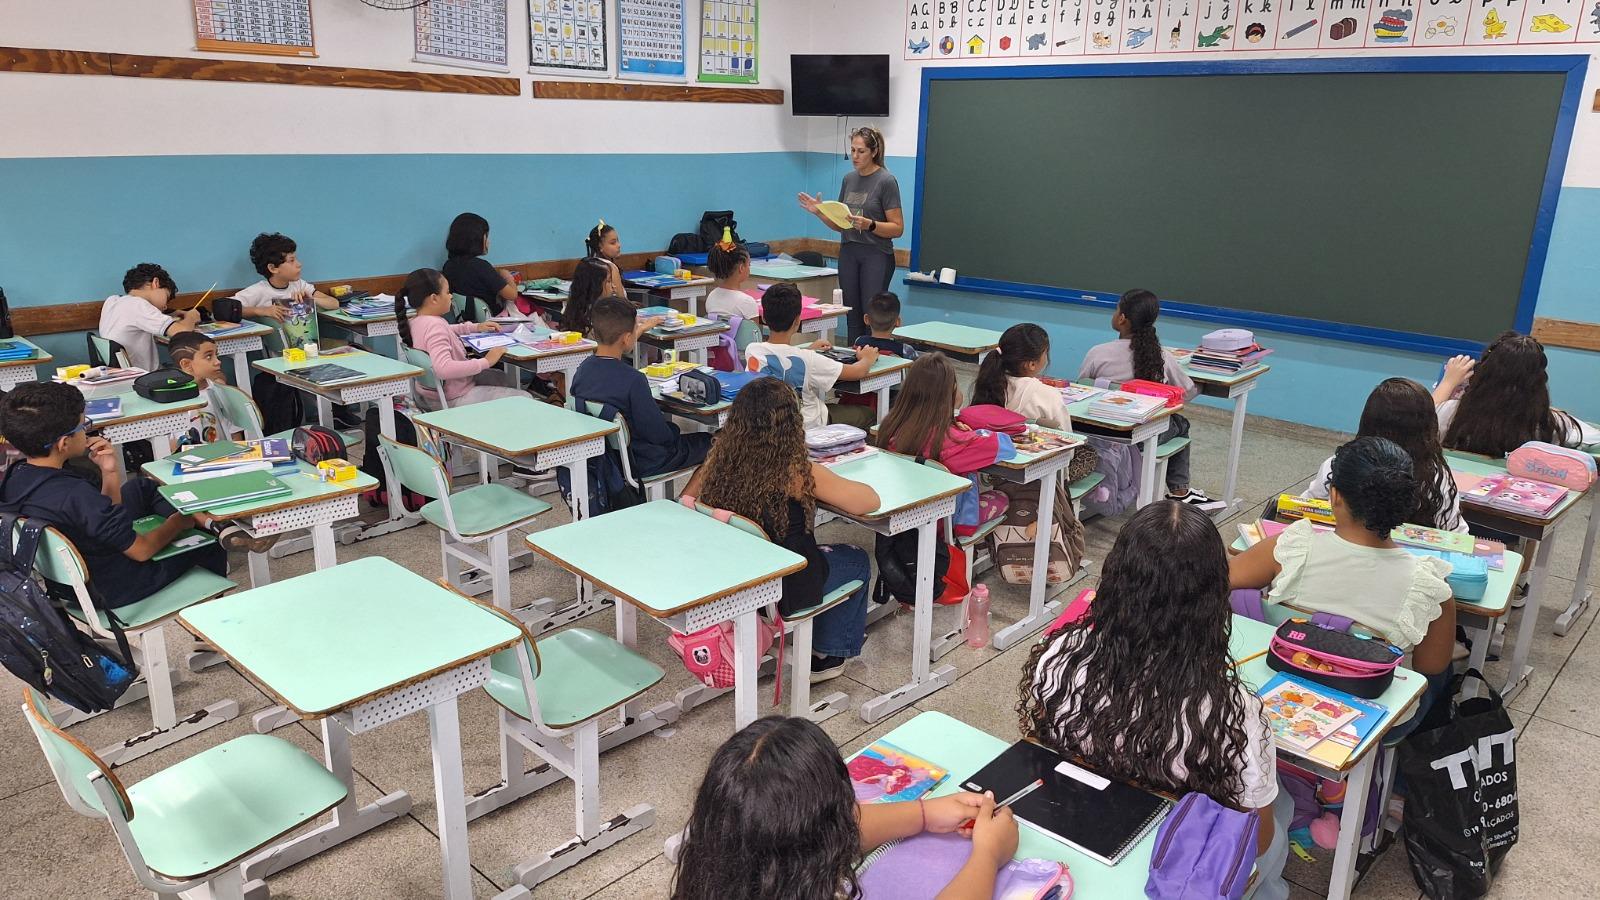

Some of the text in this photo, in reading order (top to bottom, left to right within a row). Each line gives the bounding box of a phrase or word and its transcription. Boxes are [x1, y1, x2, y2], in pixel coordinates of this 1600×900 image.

[911, 4, 917, 16] A
[939, 2, 945, 14] B
[911, 21, 916, 30] a
[939, 18, 944, 28] b
[968, 18, 973, 27] c
[997, 14, 1002, 25] d
[1009, 13, 1016, 24] d
[1027, 15, 1033, 24] e
[1060, 10, 1065, 22] f
[1094, 12, 1100, 24] g
[1129, 7, 1135, 18] h
[1168, 4, 1170, 16] i
[1204, 2, 1211, 19] j
